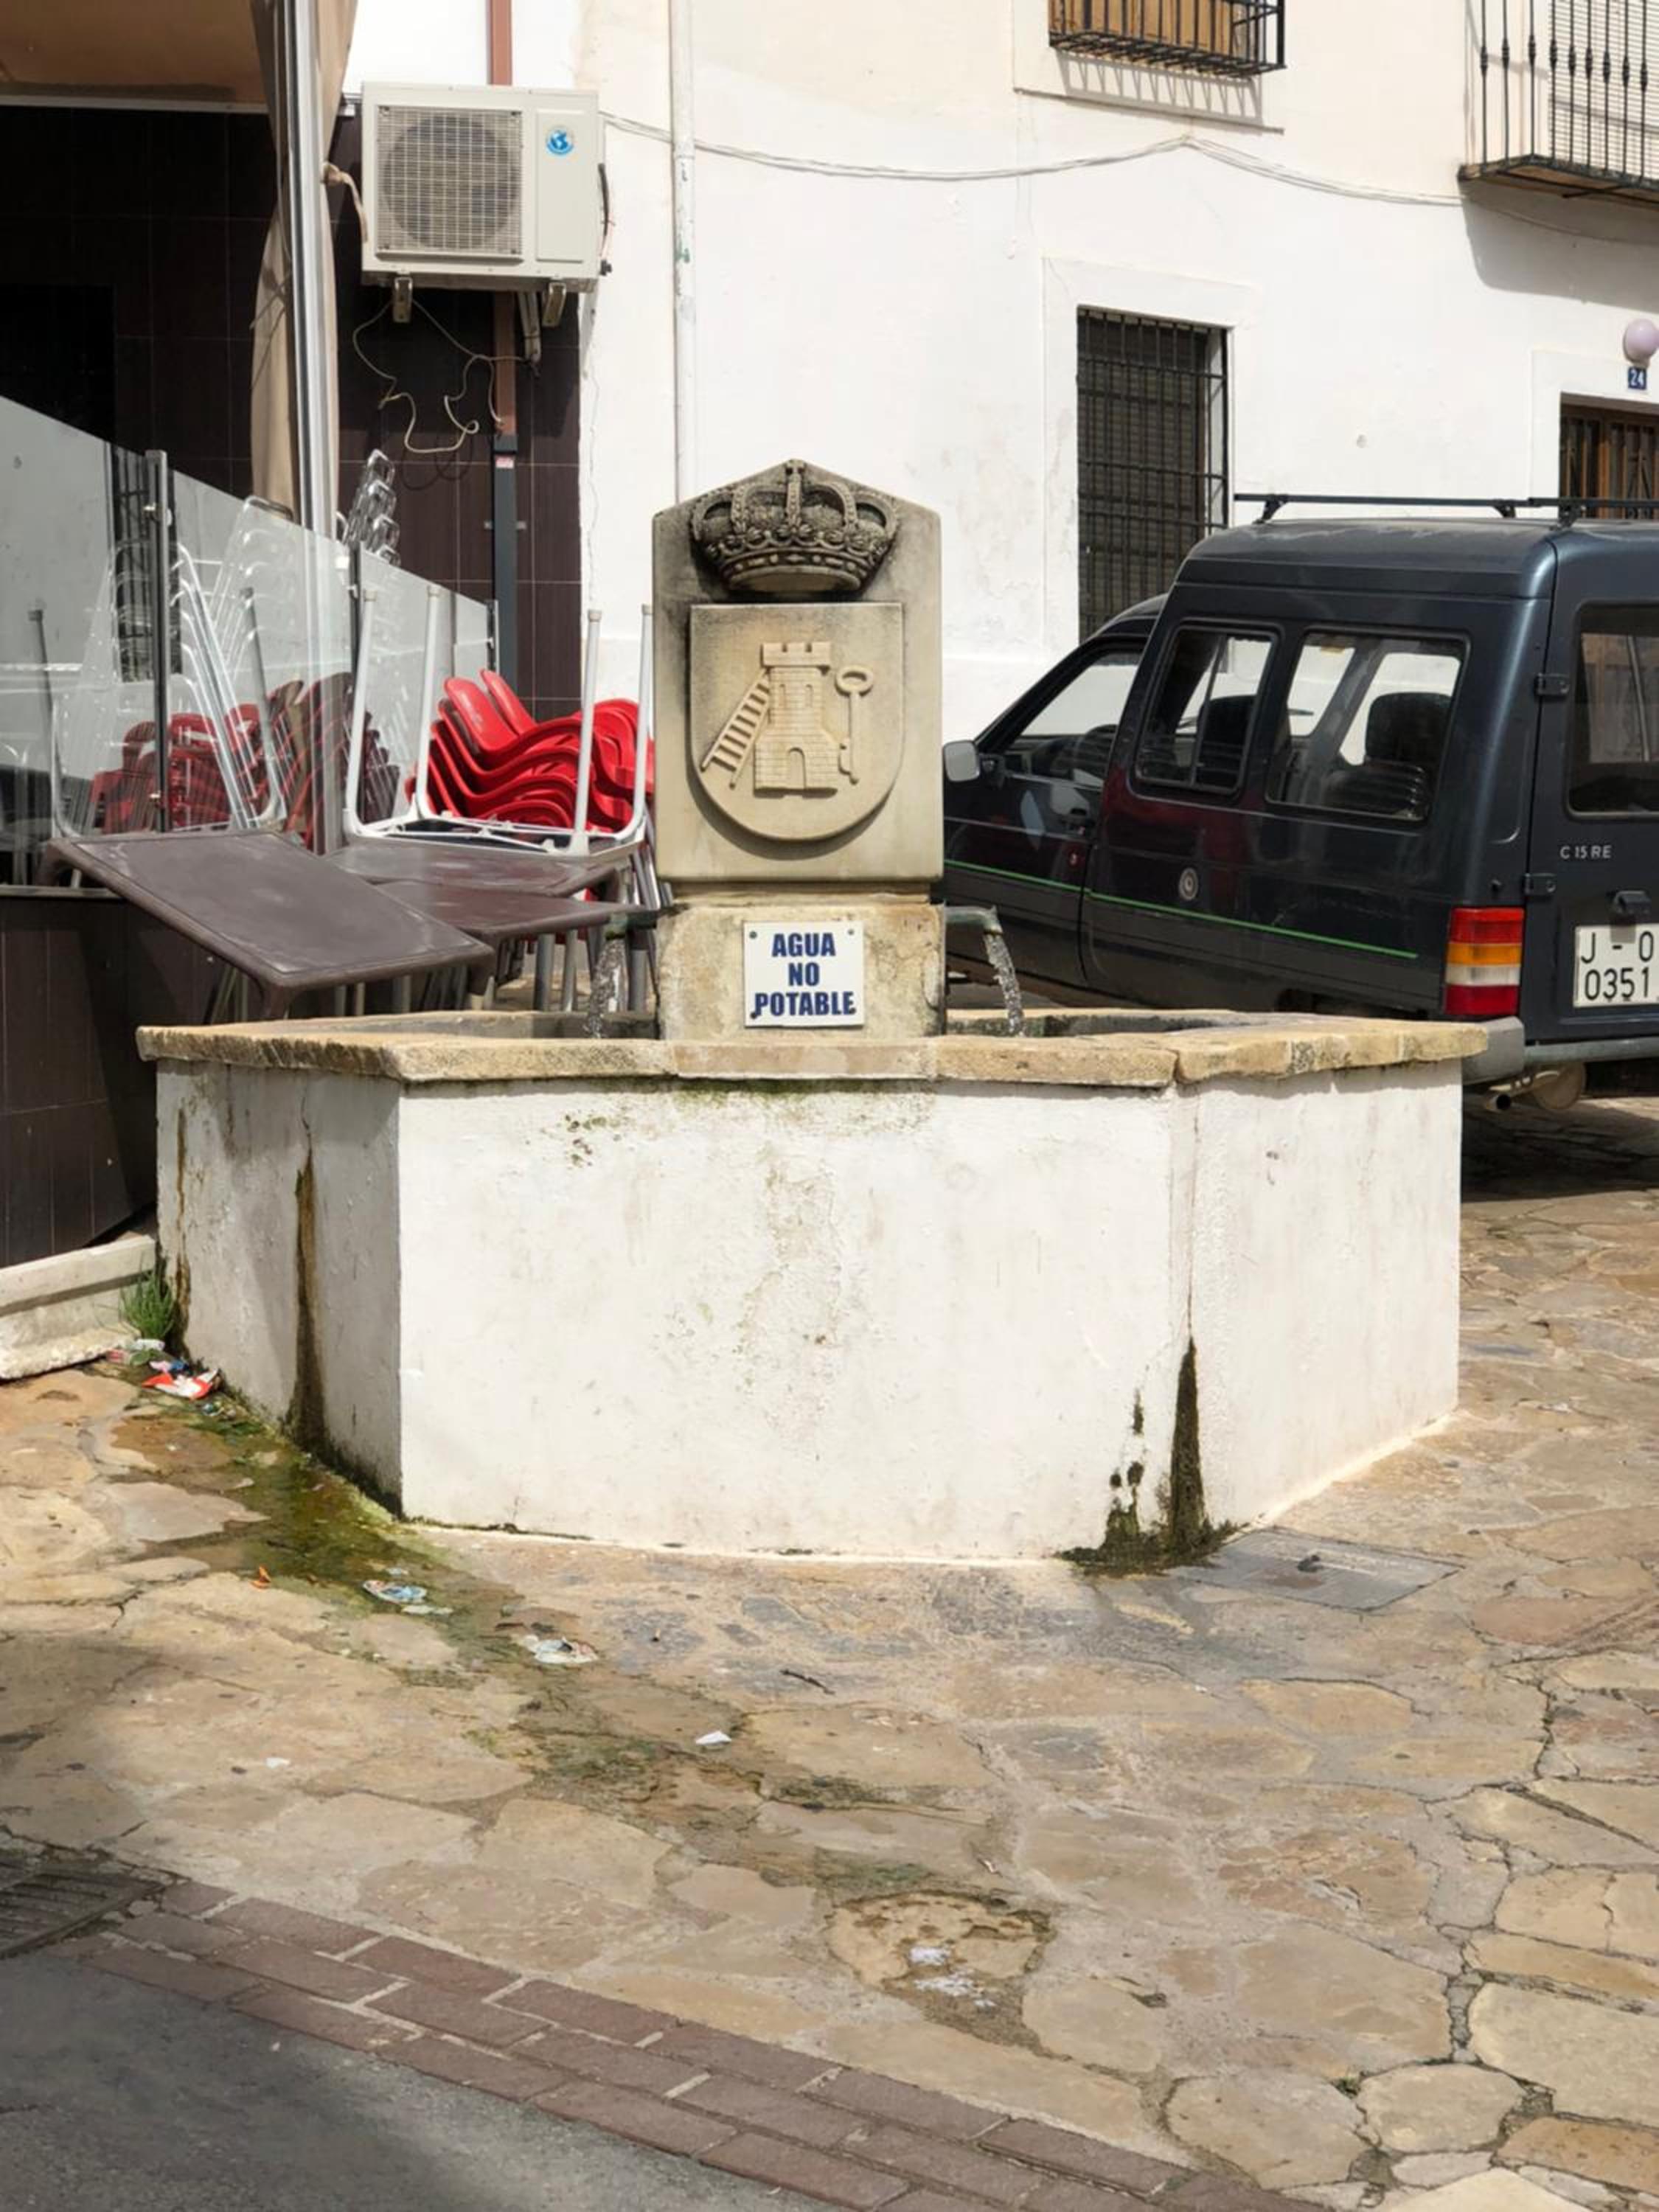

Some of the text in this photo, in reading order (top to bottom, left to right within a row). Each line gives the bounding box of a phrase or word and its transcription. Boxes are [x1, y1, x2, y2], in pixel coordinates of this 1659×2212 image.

[1630, 369, 1644, 386] 24
[771, 932, 836, 958] AGUA
[787, 961, 820, 987] NO
[1585, 966, 1649, 1001] 0351
[754, 991, 855, 1017] POTABLE
